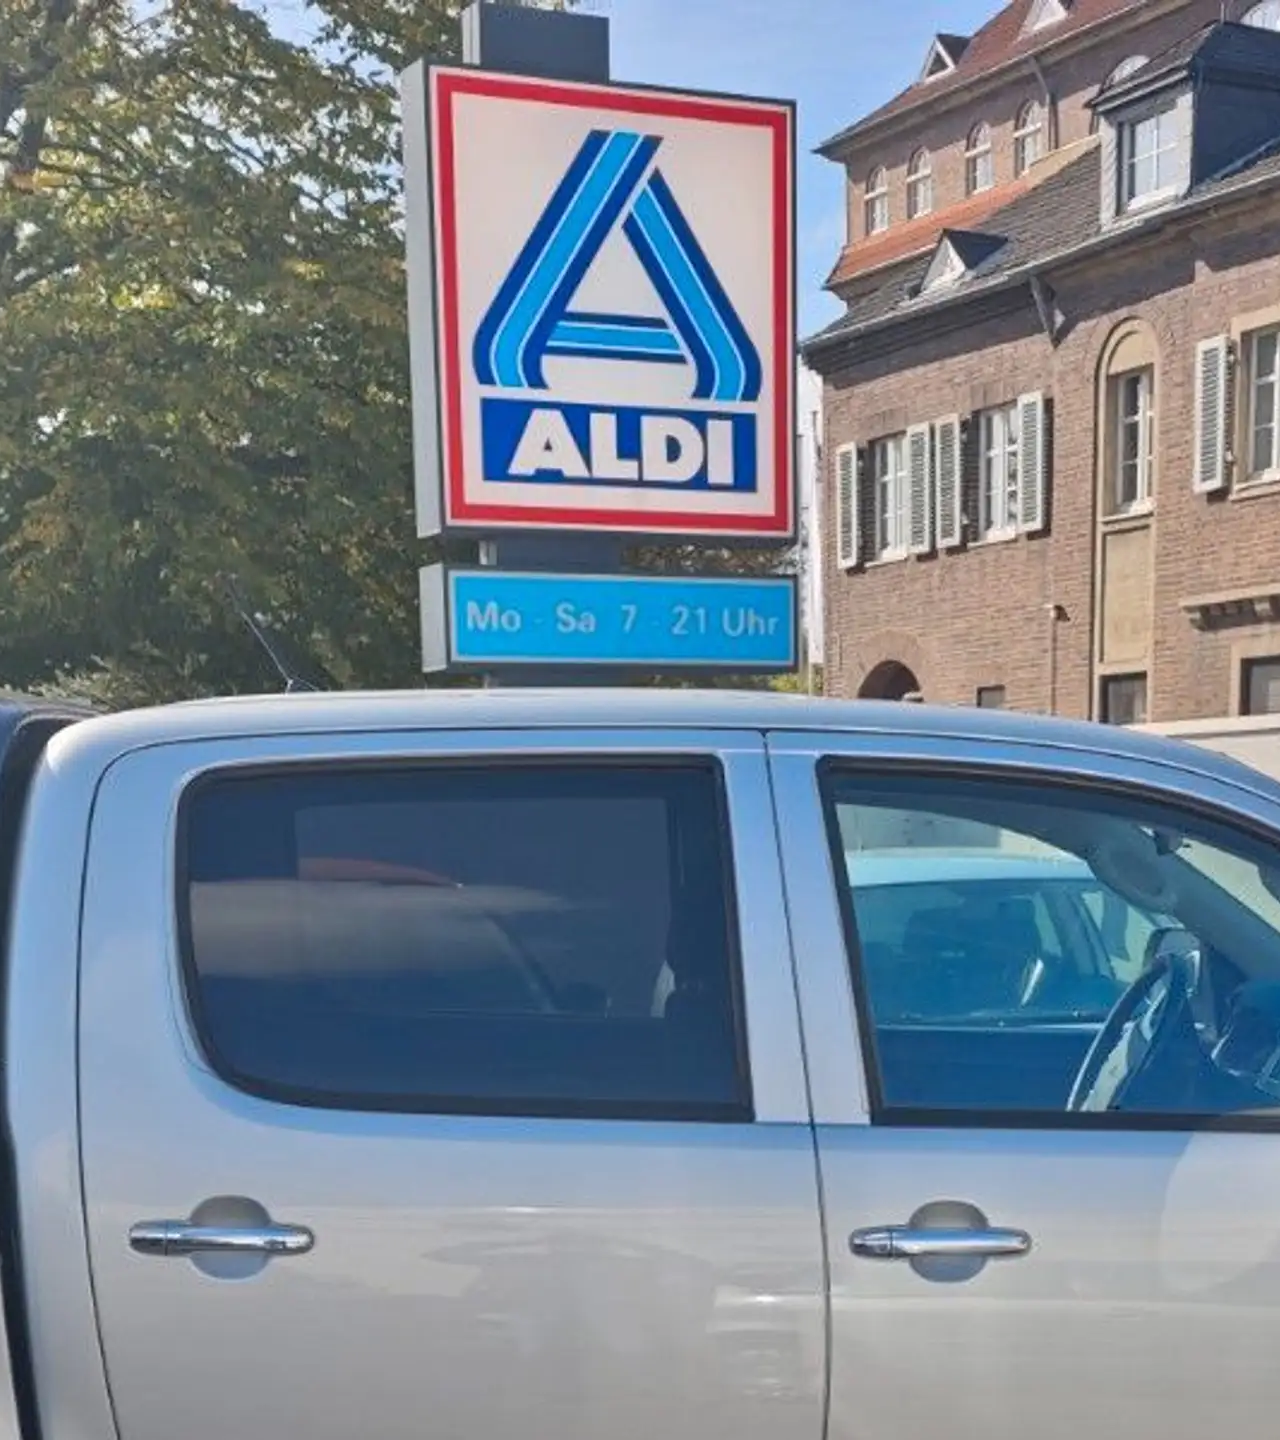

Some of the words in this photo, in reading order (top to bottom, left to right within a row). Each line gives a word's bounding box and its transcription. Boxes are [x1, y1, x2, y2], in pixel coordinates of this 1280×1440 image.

[507, 408, 736, 487] ALDI
[466, 600, 522, 633] Mo
[555, 603, 597, 633] Sa
[620, 604, 638, 633] 7
[671, 605, 706, 635] 21
[722, 608, 779, 637] Uhr
